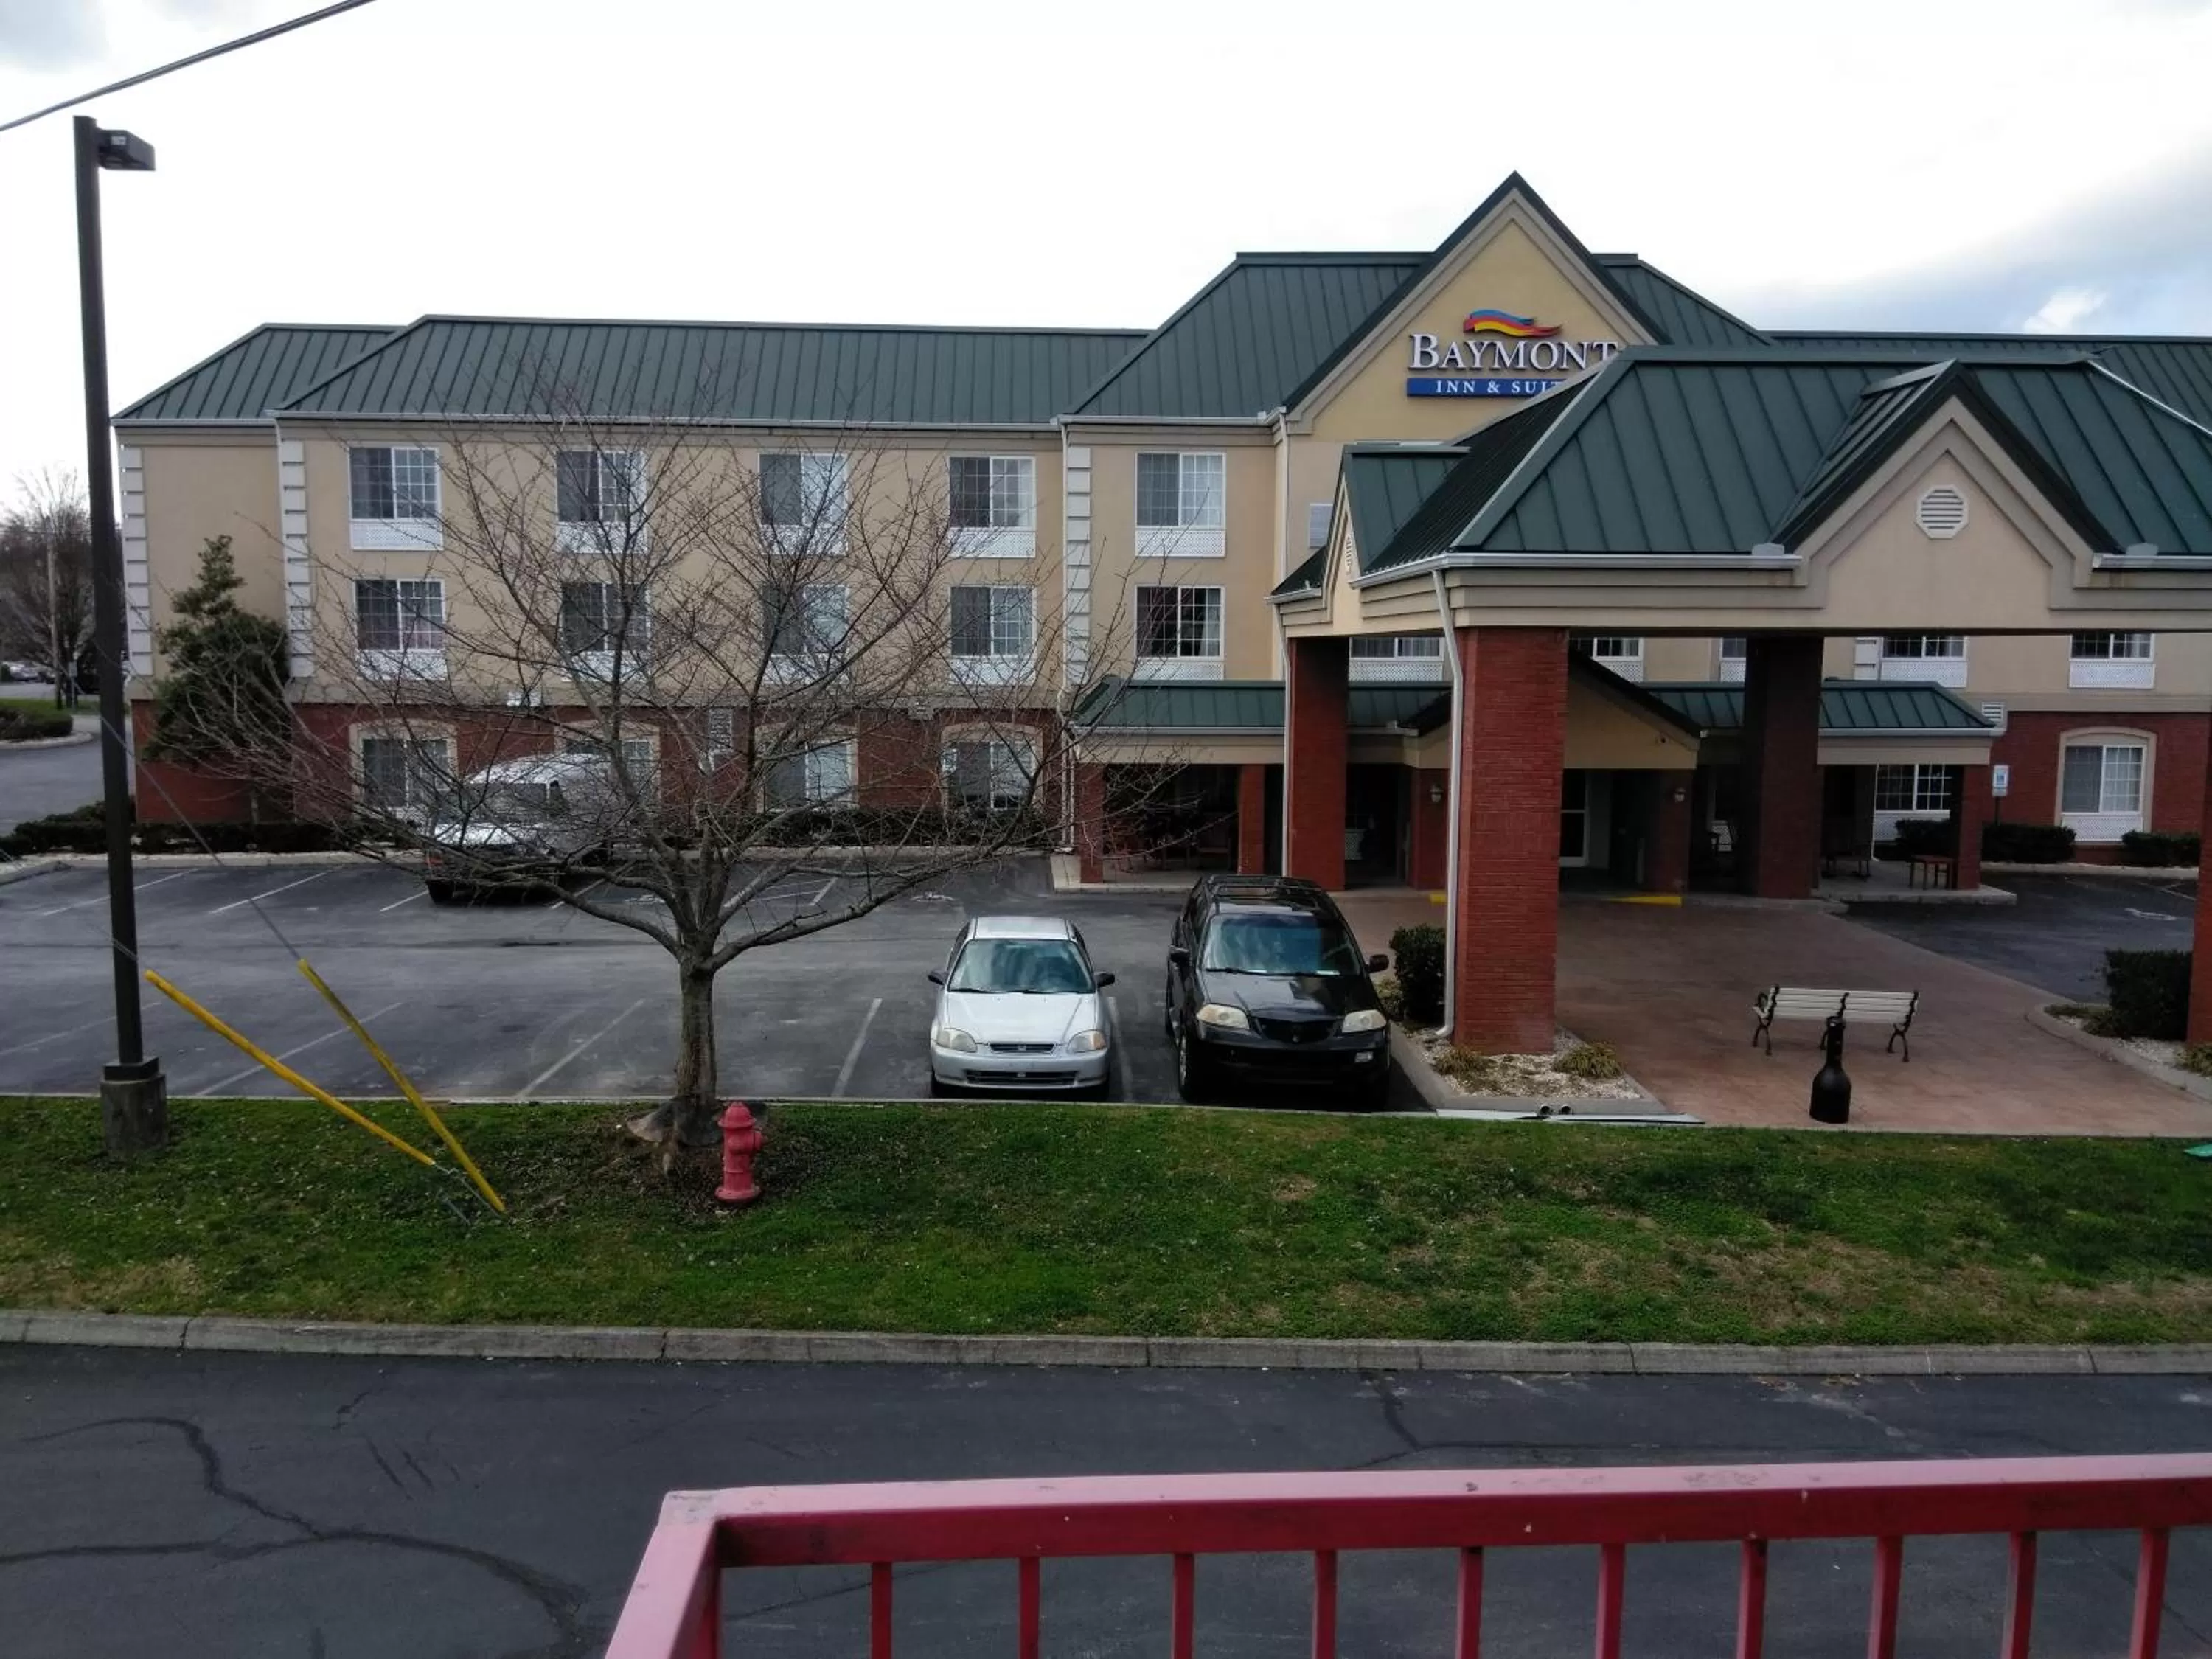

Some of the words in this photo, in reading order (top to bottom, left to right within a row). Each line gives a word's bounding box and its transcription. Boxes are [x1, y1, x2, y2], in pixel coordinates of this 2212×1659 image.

[1409, 333, 1618, 369] BAYMONT
[1436, 380, 1475, 393] INN
[1487, 380, 1500, 393] &
